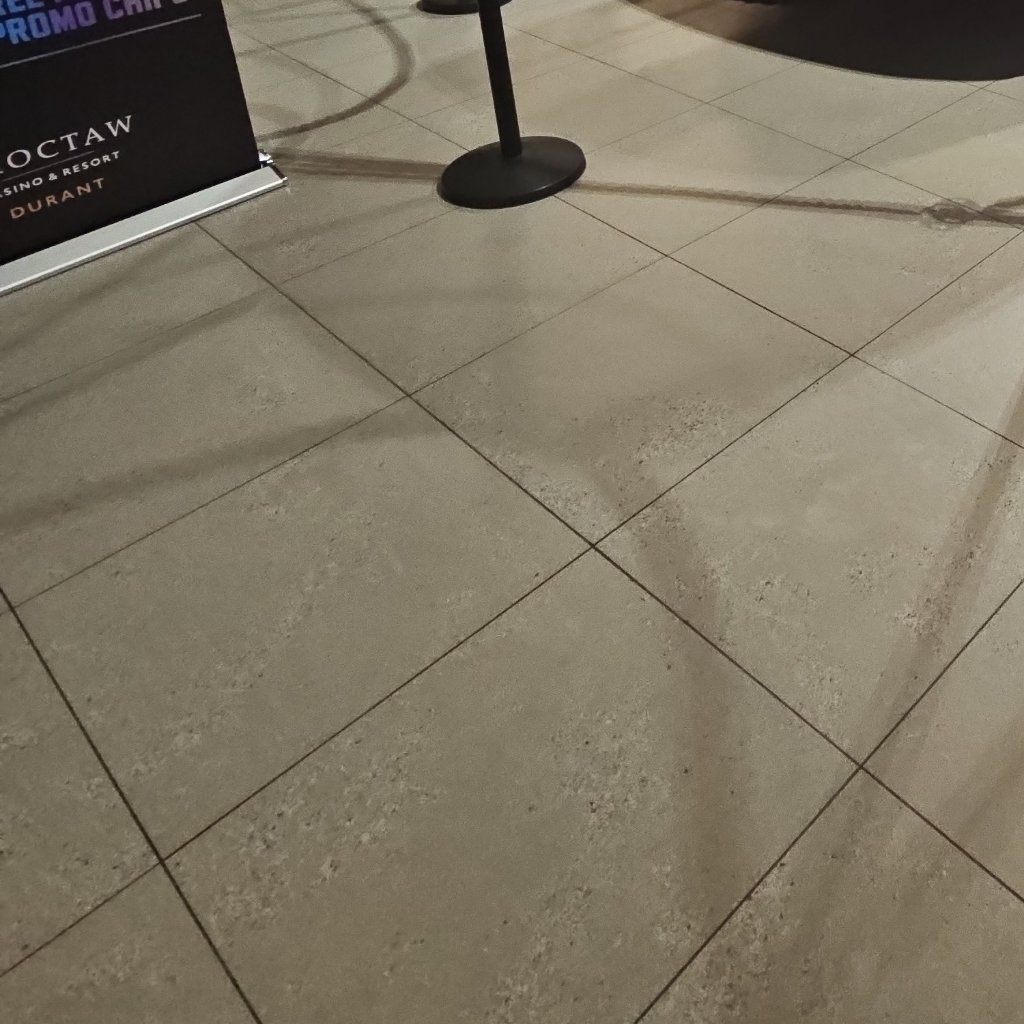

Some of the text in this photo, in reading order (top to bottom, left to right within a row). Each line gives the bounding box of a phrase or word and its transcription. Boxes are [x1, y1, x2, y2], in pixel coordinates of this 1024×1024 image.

[0, 0, 97, 45] ROMO
[0, 115, 132, 173] OCTAW
[0, 177, 43, 198] SINO
[62, 150, 120, 176] RESORT
[10, 177, 104, 219] DURANT
